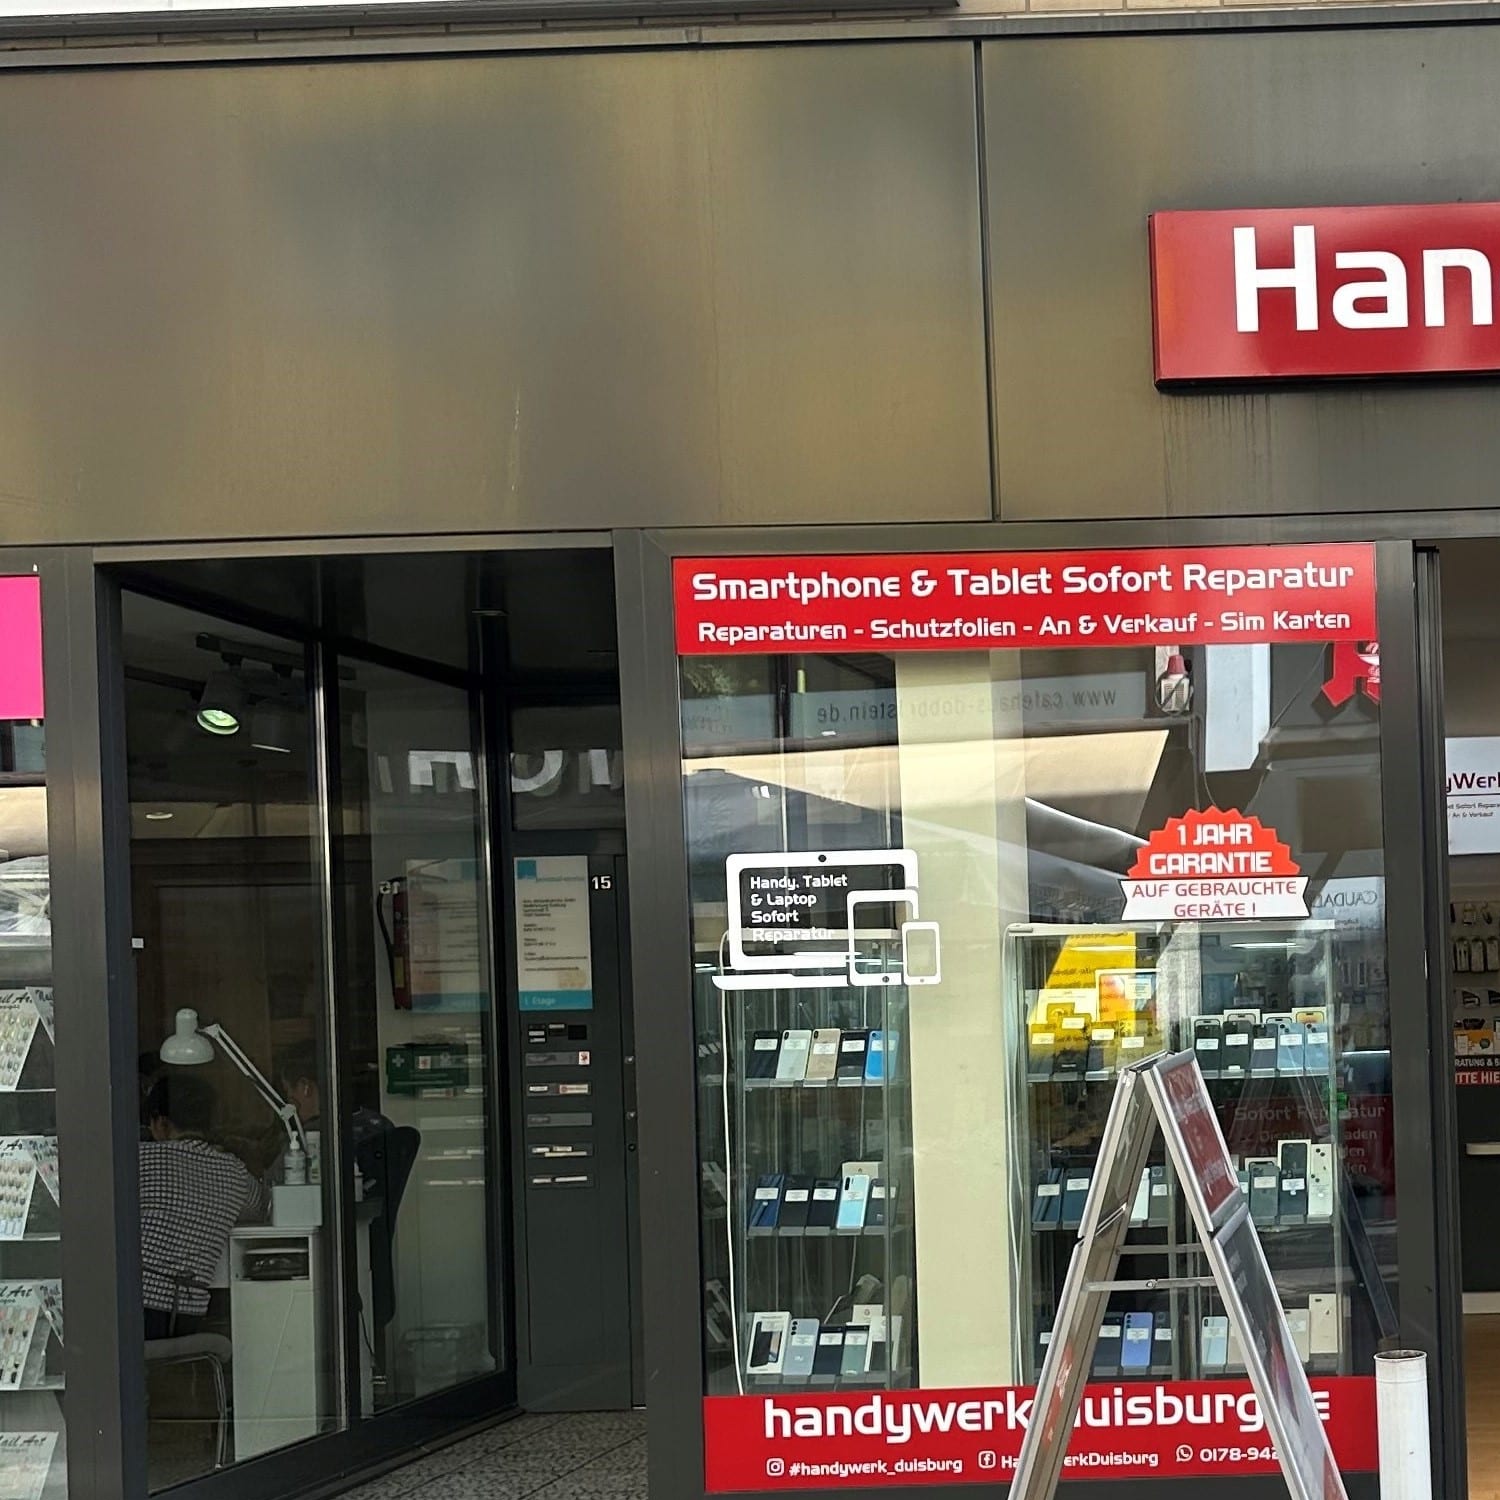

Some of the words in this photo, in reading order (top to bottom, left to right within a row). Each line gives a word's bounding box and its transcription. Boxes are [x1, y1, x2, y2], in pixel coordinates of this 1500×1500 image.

[692, 570, 901, 605] Smartphone
[911, 569, 938, 597] &
[946, 563, 1053, 597] Tablet
[1062, 563, 1173, 594] Sofort
[1183, 561, 1355, 597] Reparatur
[697, 621, 848, 646] Reparaturen
[869, 617, 1016, 640] Schutzfolien
[1038, 615, 1071, 636] An
[1078, 614, 1098, 635] &
[1103, 612, 1198, 635] Verkauf
[1220, 611, 1265, 632] Sim
[1272, 609, 1351, 631] Karten
[1177, 824, 1187, 846] 1
[1192, 823, 1254, 846] JAHR
[1149, 851, 1273, 875] GARANTIE
[591, 875, 612, 890] 15
[802, 873, 849, 888] Tablet
[1132, 882, 1170, 898] AUF
[1174, 881, 1297, 897] GEBRAUCHTE
[750, 893, 763, 907] &
[766, 892, 817, 909] Laptop
[1174, 900, 1246, 918] GERÄTE
[751, 909, 800, 924] Sofort
[751, 926, 834, 945] Reparatur
[1233, 1106, 1291, 1121] Sofort
